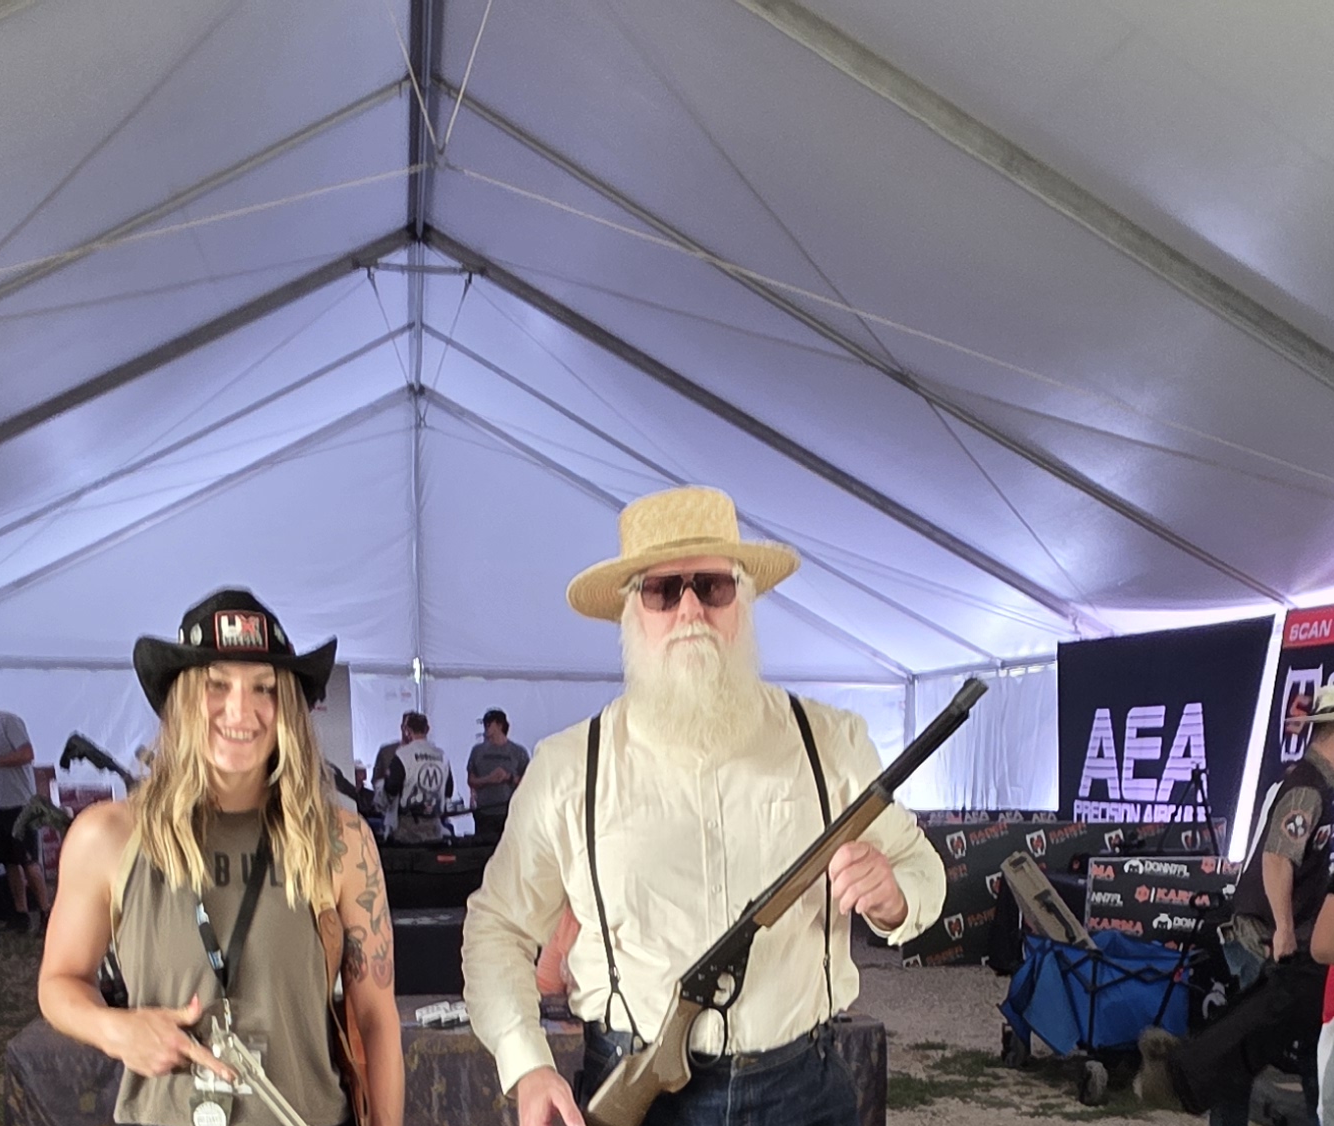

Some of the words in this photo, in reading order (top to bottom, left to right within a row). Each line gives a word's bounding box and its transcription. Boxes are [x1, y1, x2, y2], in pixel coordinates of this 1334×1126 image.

[1289, 621, 1331, 642] SCAN
[1078, 703, 1208, 803] AEA
[1073, 800, 1141, 823] PRECISION
